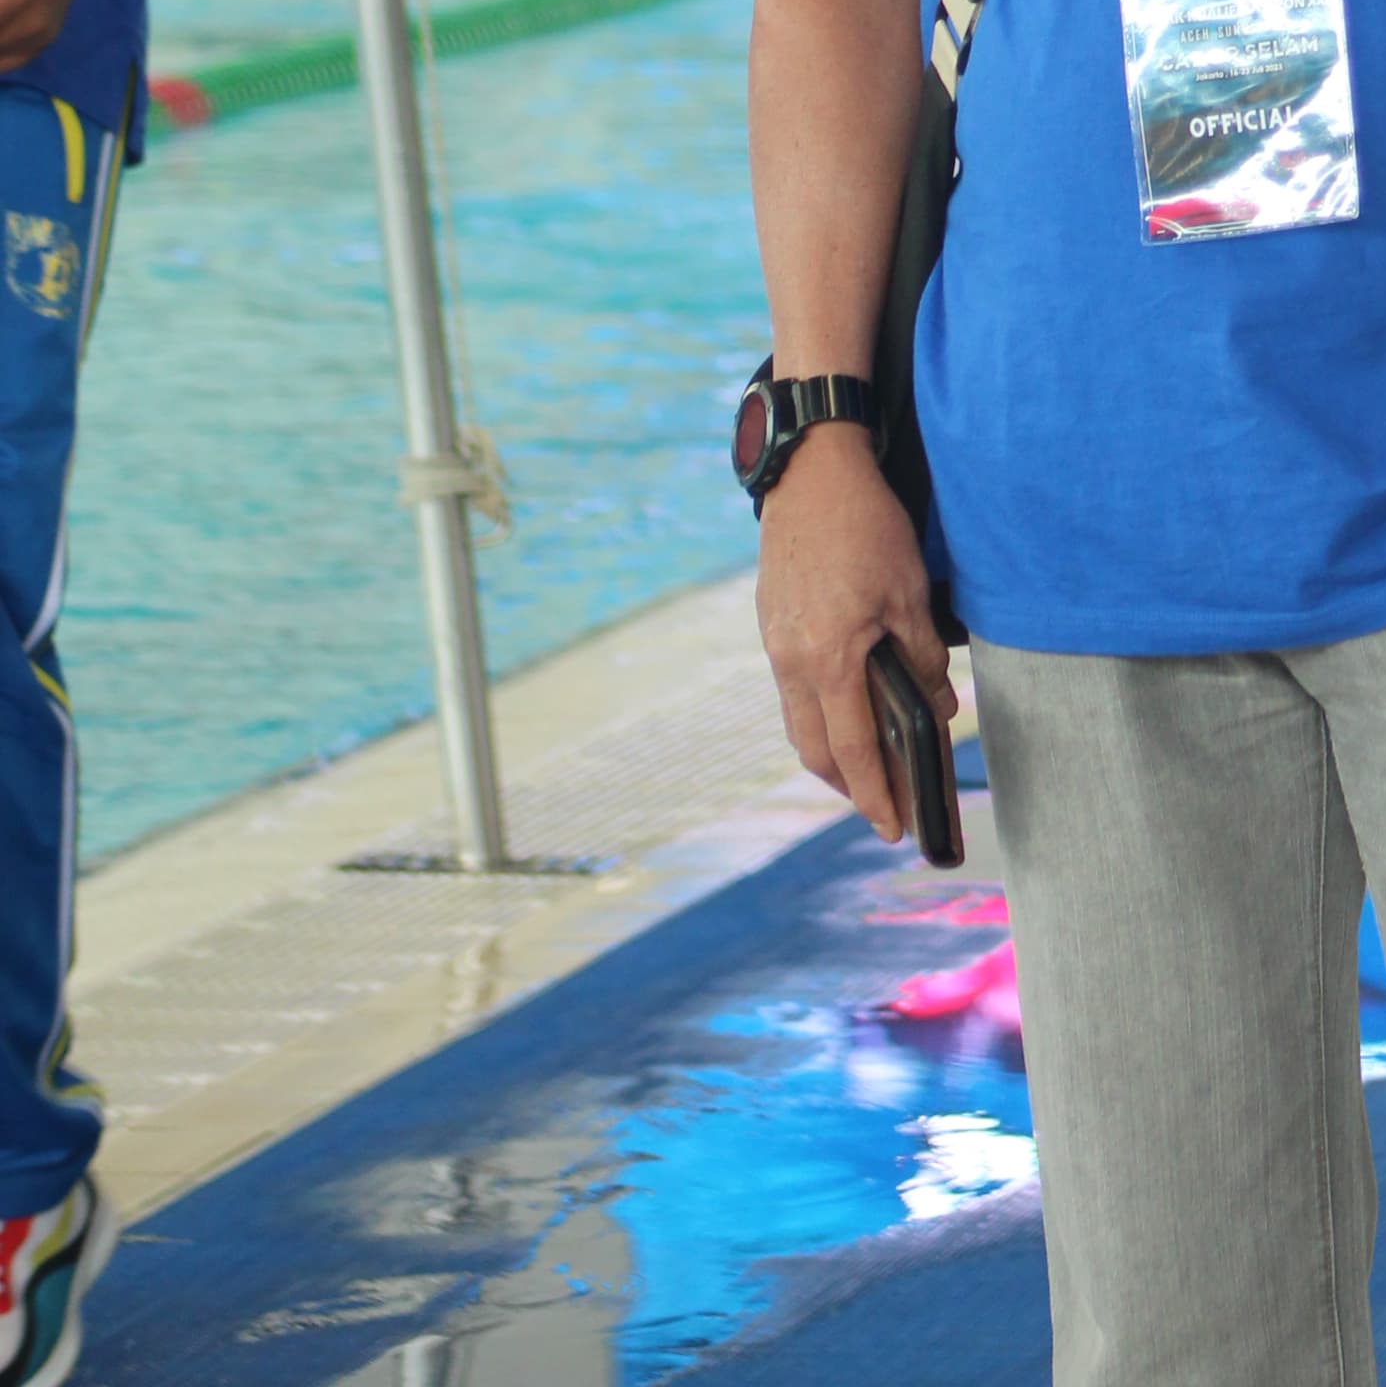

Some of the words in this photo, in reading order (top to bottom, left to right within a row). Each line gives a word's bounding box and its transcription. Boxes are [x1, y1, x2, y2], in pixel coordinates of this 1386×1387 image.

[1180, 27, 1210, 44] ACEH
[1245, 33, 1319, 61] SELAM
[1189, 105, 1294, 139] OFFICIAL
